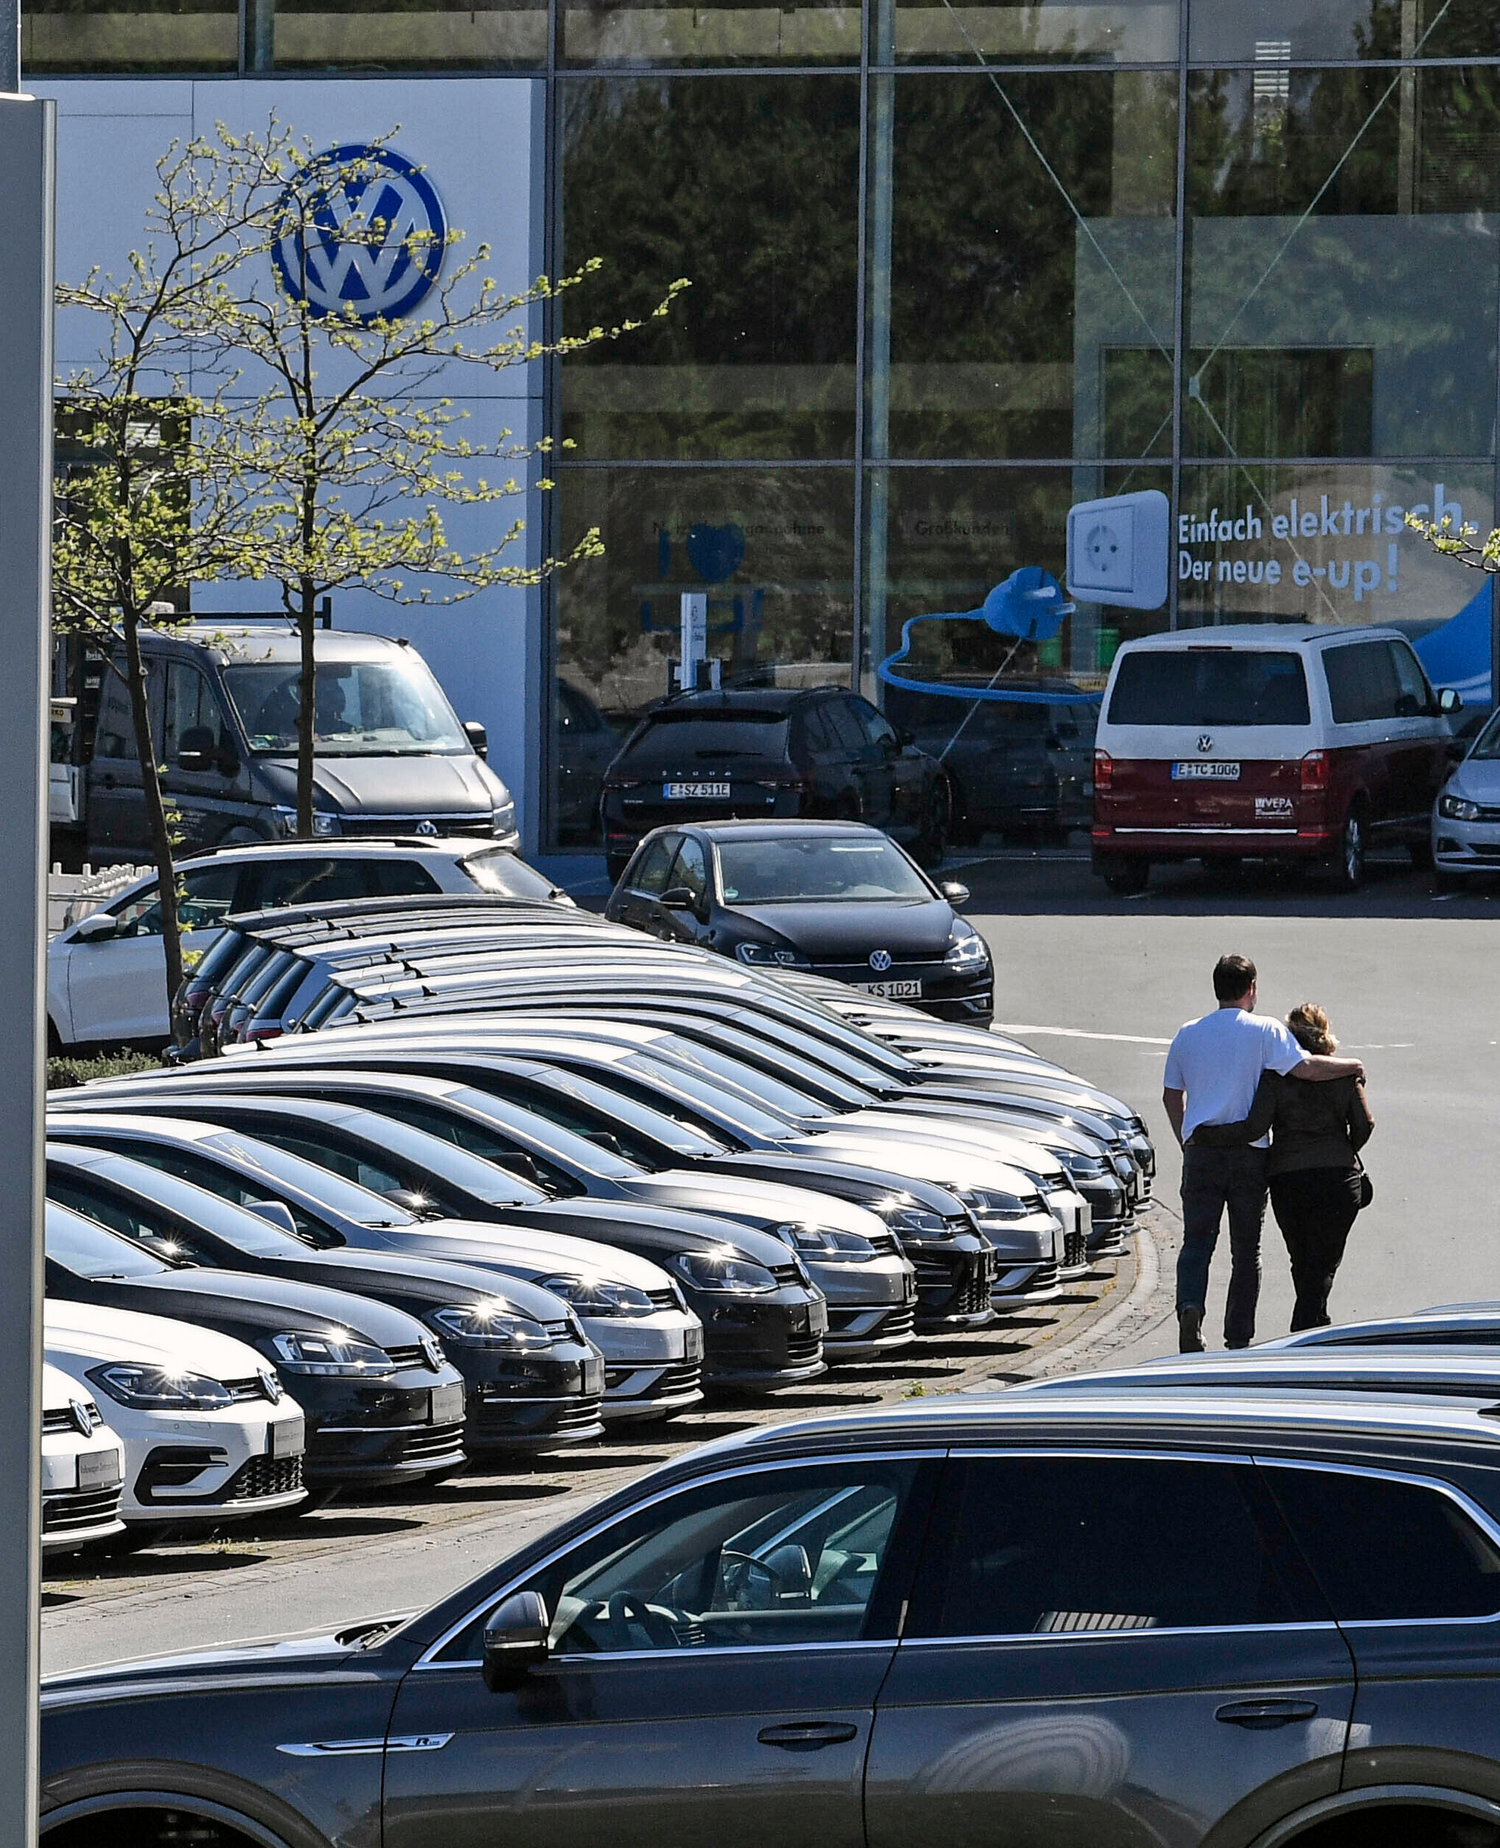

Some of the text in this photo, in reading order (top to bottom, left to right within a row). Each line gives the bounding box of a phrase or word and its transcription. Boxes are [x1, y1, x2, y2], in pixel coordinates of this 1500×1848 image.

[1178, 504, 1262, 544] Einfach
[1178, 543, 1398, 602] Der neue e-up!
